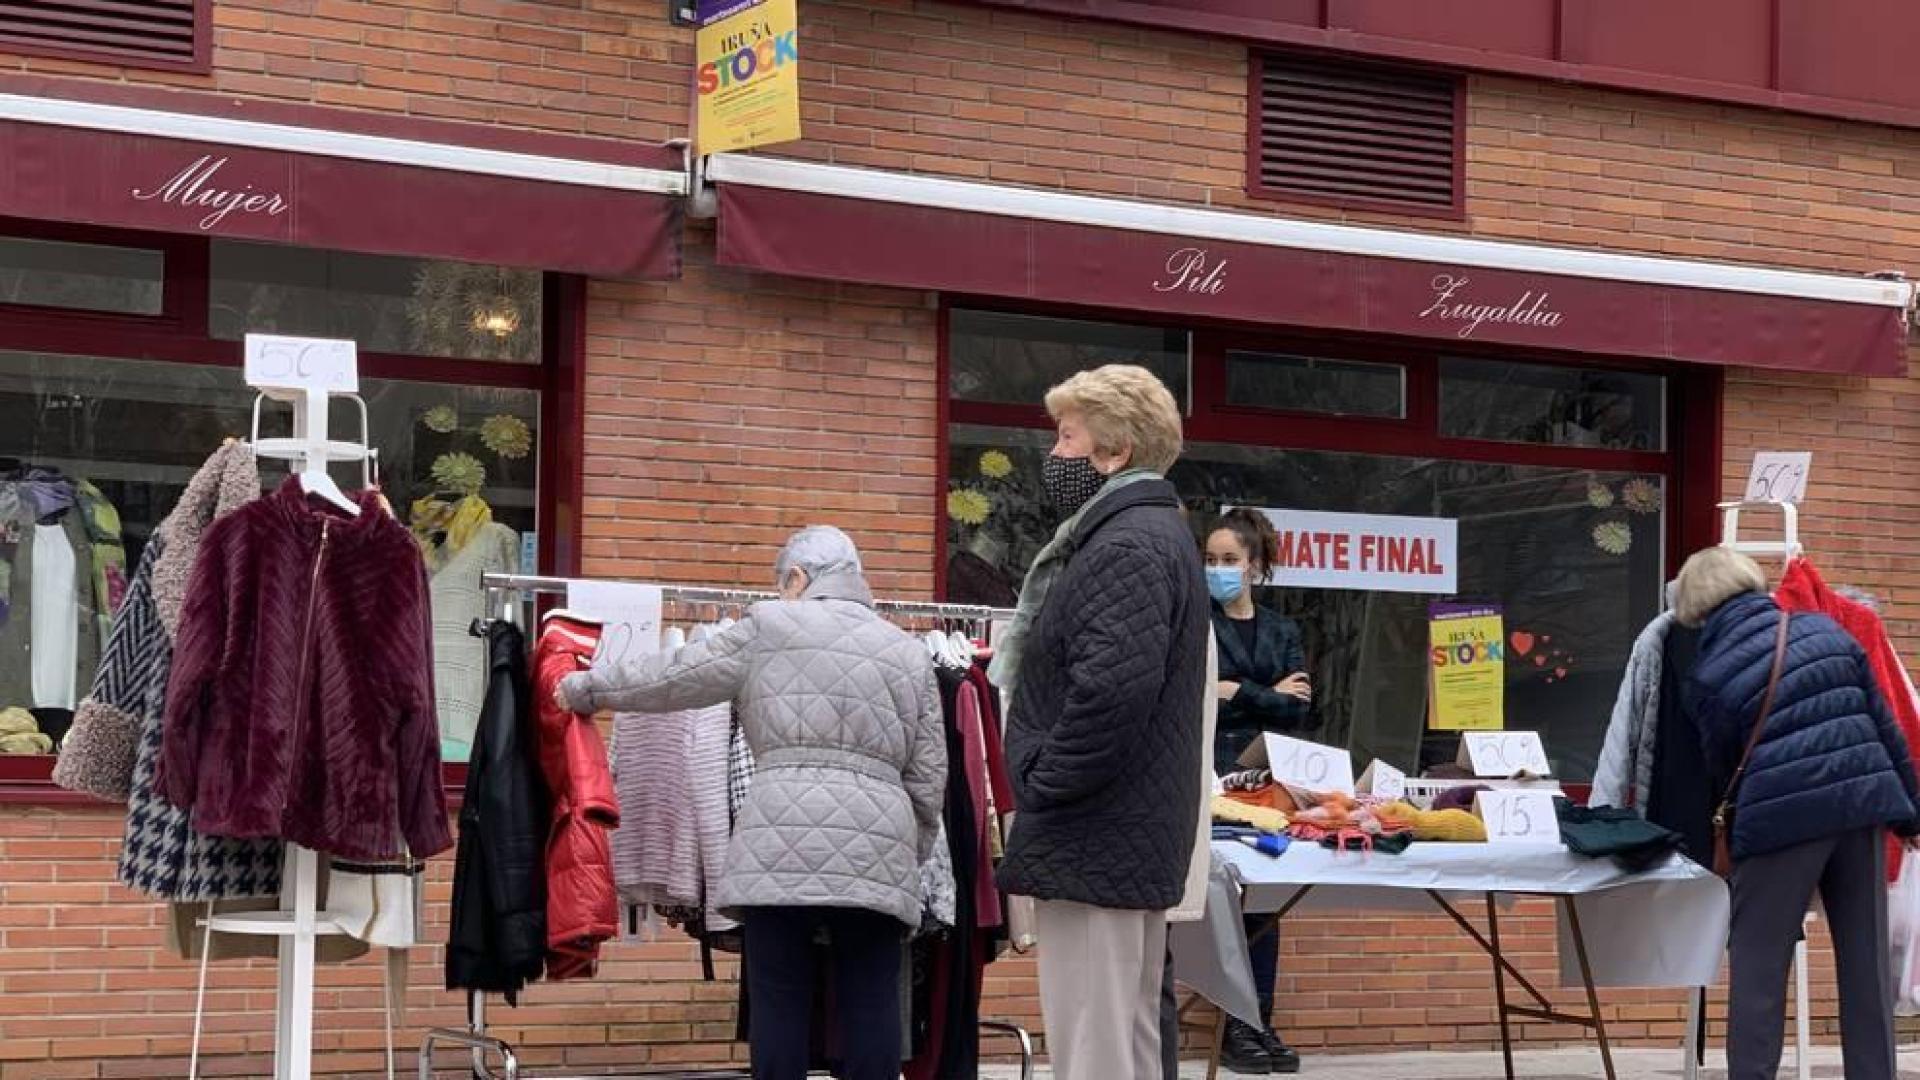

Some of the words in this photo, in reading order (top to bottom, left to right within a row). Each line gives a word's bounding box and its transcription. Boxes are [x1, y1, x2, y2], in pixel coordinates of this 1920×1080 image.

[697, 30, 798, 95] STOCK
[131, 154, 288, 230] Mujer
[1152, 247, 1227, 297] Pili
[1418, 273, 1564, 338] Zugaldia
[1359, 534, 1444, 576] FINAL
[1433, 641, 1503, 667] STOCK
[1498, 793, 1532, 838] 15
